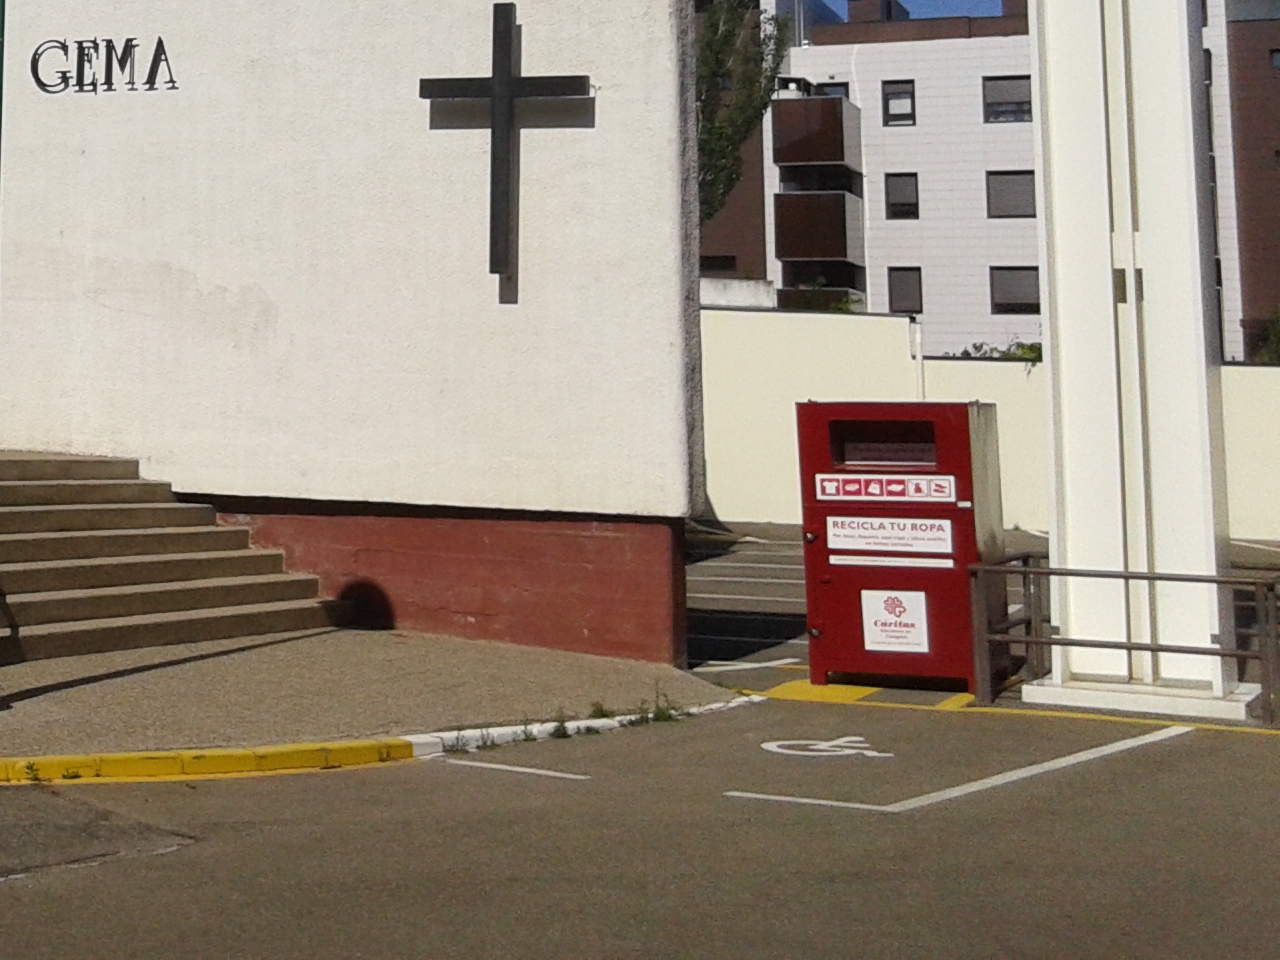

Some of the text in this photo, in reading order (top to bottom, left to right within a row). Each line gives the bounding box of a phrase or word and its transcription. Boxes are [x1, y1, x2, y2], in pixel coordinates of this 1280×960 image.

[30, 36, 179, 95] GEMA
[832, 520, 945, 533] RECICLA TU ROPA
